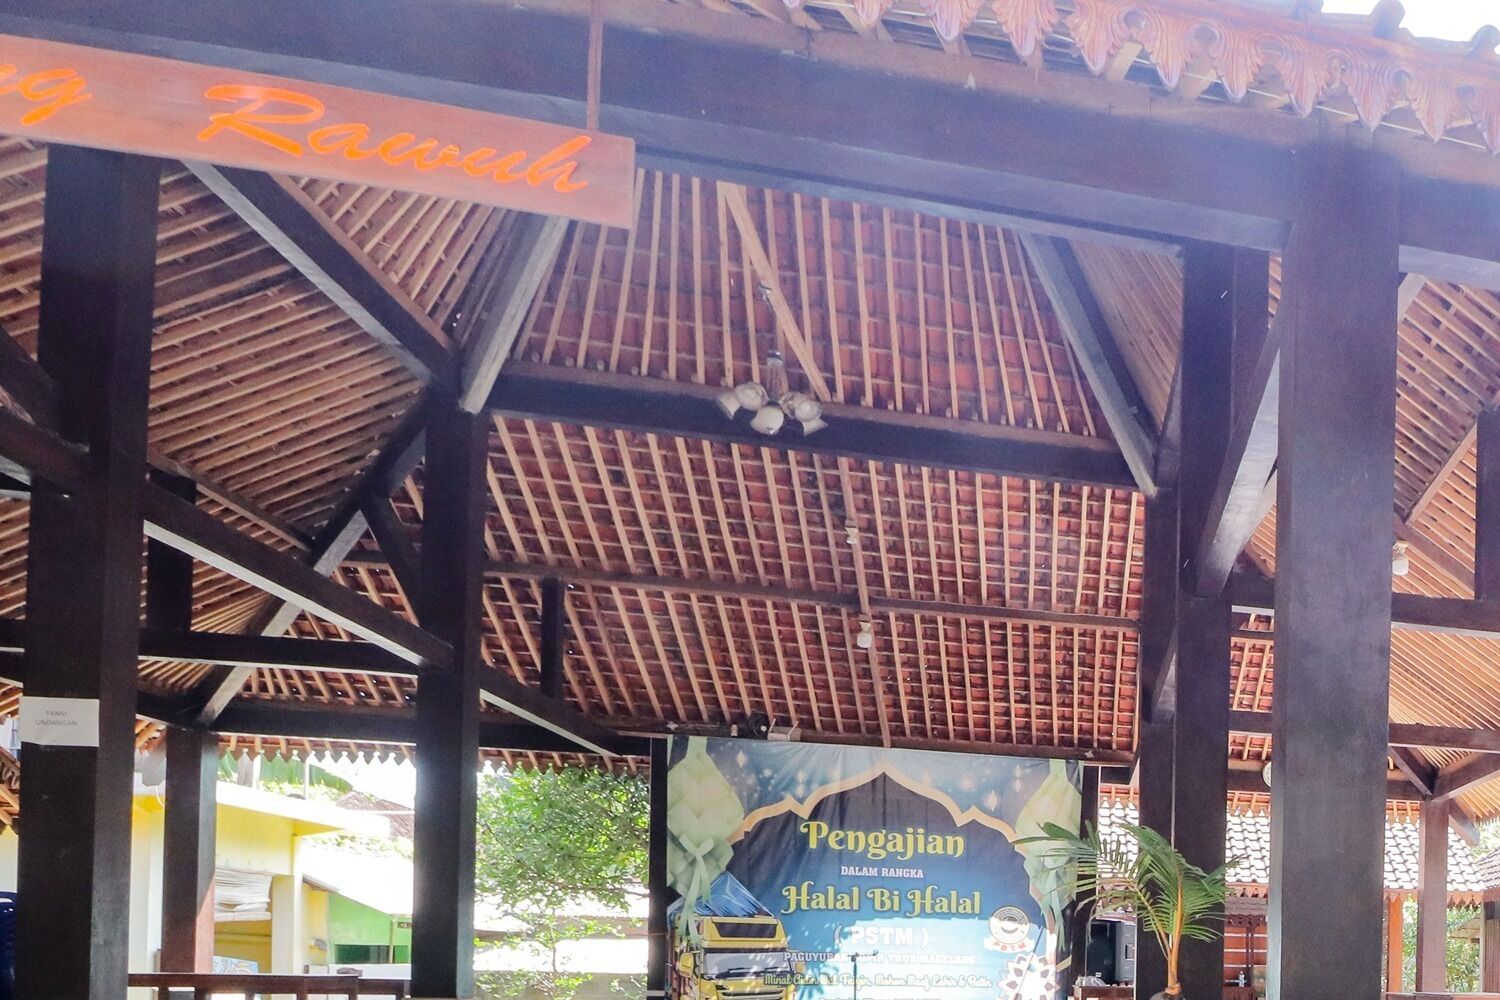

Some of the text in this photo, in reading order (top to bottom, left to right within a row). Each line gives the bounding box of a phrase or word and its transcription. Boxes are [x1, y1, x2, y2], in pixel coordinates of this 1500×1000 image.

[197, 85, 593, 193] Rawuh
[799, 820, 966, 861] Pengajian
[840, 865, 924, 879] DALAM RANGKA
[780, 880, 982, 918] Halal Bi Halal
